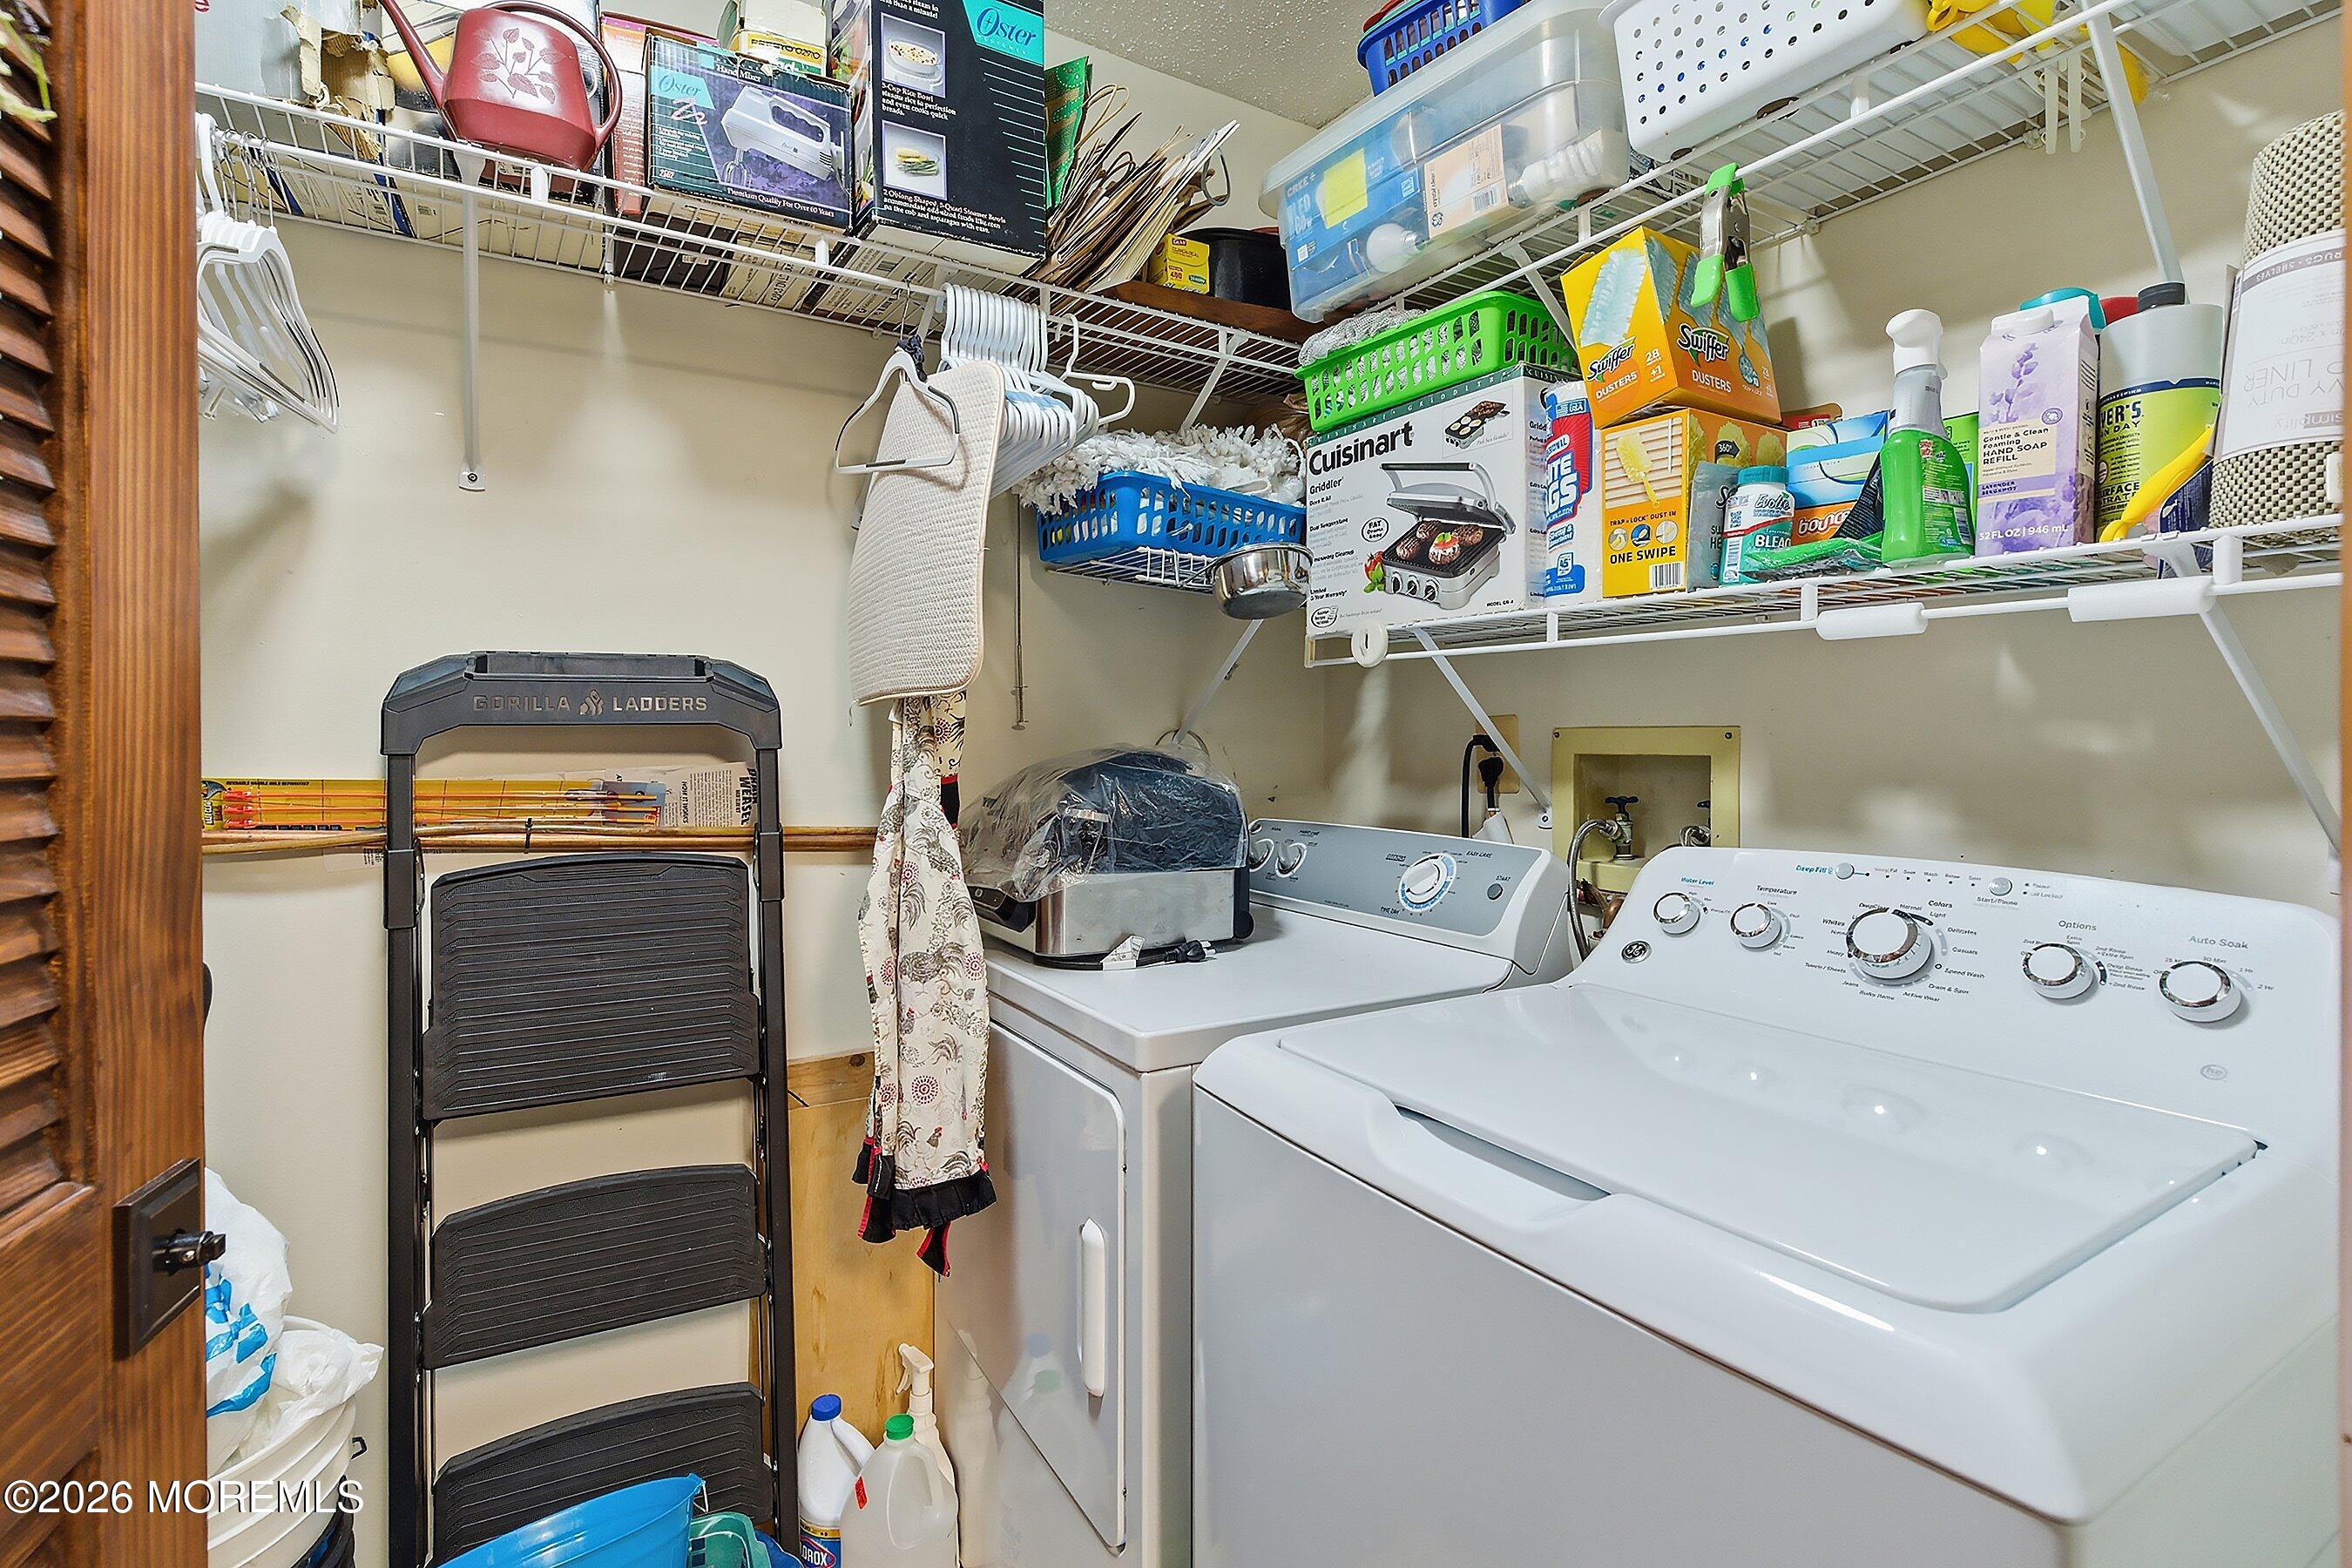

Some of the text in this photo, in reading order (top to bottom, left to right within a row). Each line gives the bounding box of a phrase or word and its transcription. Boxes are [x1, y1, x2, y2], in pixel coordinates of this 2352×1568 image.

[977, 5, 1037, 46] Oster
[716, 64, 738, 78] Hand
[659, 75, 701, 97] Oster
[917, 91, 934, 102] Bowl
[924, 103, 956, 115] perfection
[930, 111, 949, 120] quick
[727, 187, 757, 201] Premium
[758, 194, 781, 207] Quality
[794, 202, 809, 212] Over
[963, 207, 987, 219] Steamer
[1677, 324, 1729, 362] Swiffer
[1586, 340, 1635, 382] Swiffer
[1646, 348, 1659, 362] 28
[1692, 369, 1732, 393] DUSTERS
[2244, 358, 2313, 392] LINER
[1595, 372, 1638, 399] DUSTERS
[2249, 378, 2344, 408] VY DUTY
[2023, 428, 2050, 436] Clean
[2112, 421, 2141, 435] DAY
[1309, 422, 1413, 476] Cuisinart
[1984, 439, 2021, 449] Foaming
[1984, 442, 2048, 458] HAND SOAP
[1984, 454, 2018, 465] REFILL
[1548, 452, 1572, 484] ITE
[1309, 479, 1342, 494] Griddler
[1548, 472, 1578, 515] GS
[1650, 511, 1667, 520] DUST
[1369, 520, 1382, 529] FAT
[2028, 525, 2050, 536] 946
[1754, 533, 1792, 548] BLEAC
[1610, 545, 1676, 564] ONE SWIPE
[473, 695, 708, 712] GORILLA LADDERS
[1757, 885, 1798, 896] Temperature
[1929, 900, 1953, 909] Colors
[2058, 920, 2097, 931] Options
[2189, 936, 2248, 949] Auto Soak
